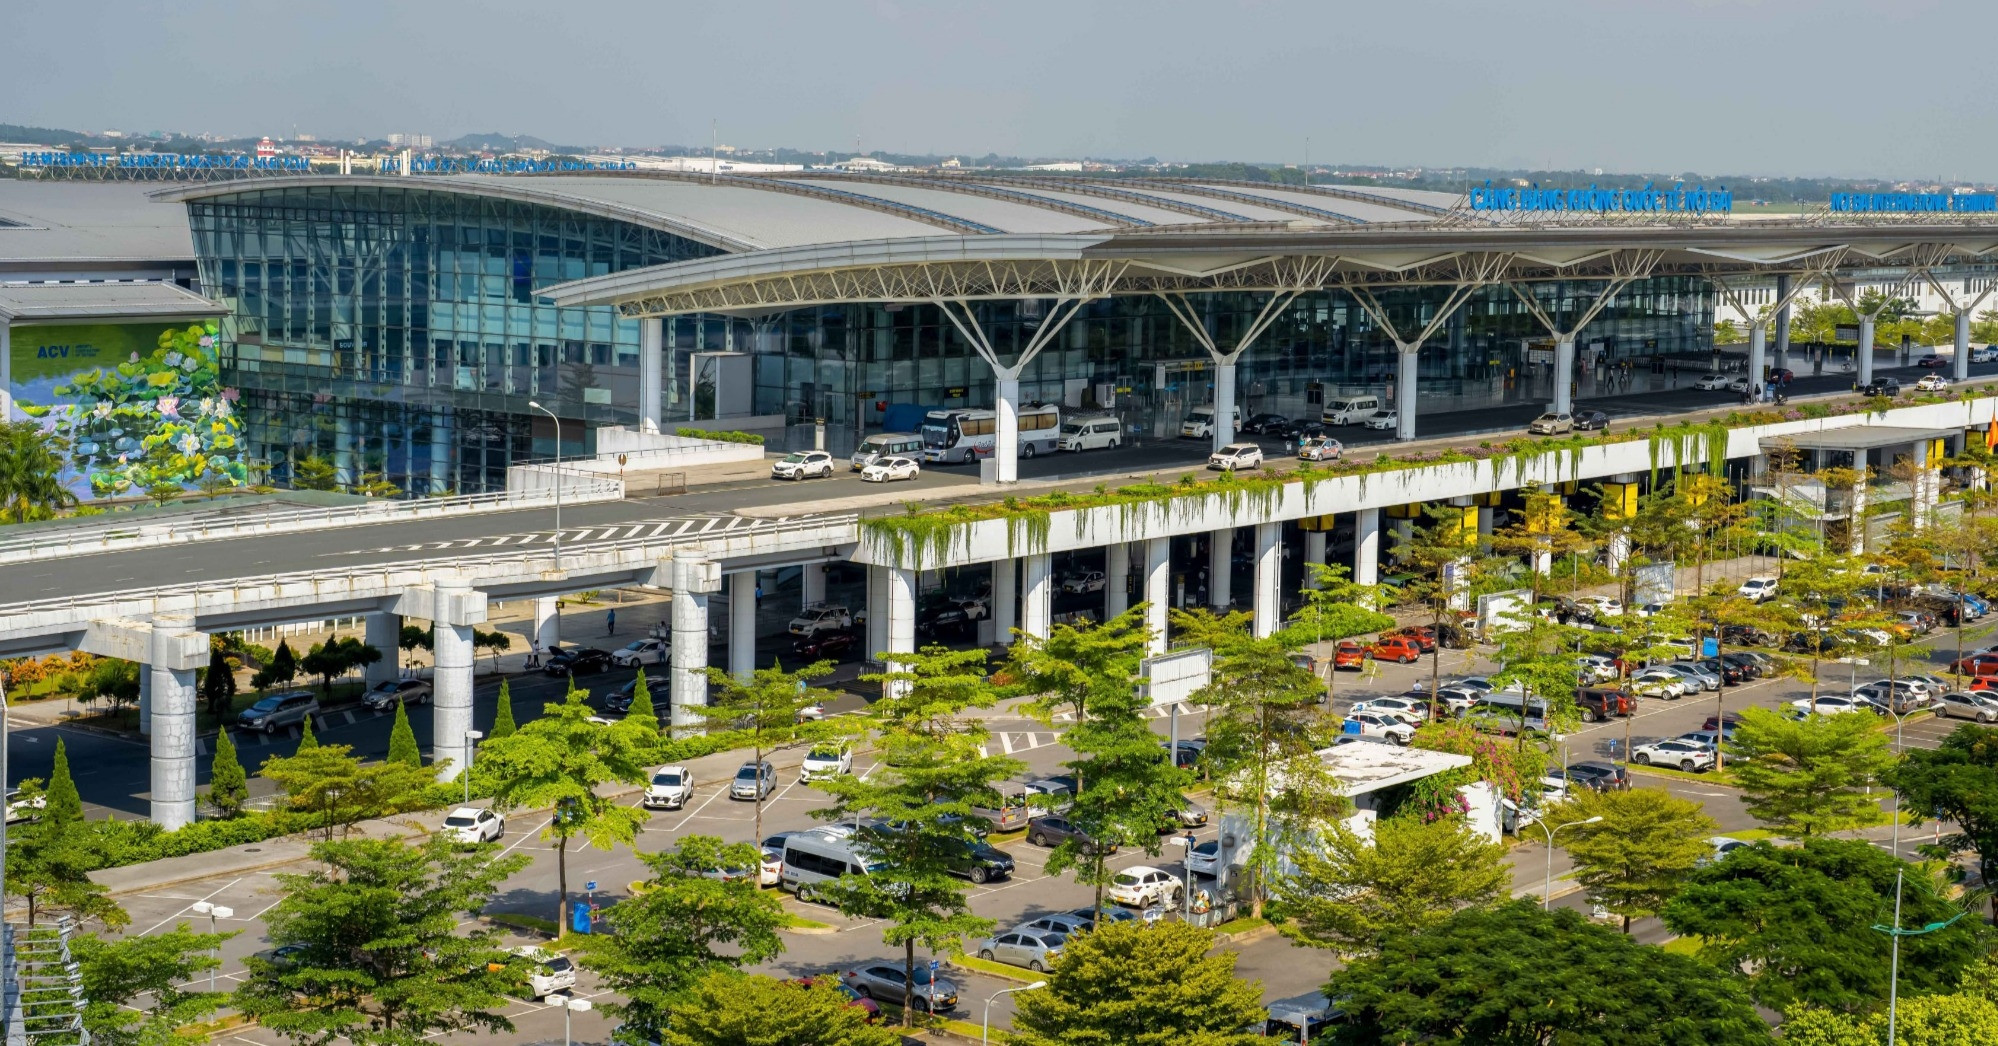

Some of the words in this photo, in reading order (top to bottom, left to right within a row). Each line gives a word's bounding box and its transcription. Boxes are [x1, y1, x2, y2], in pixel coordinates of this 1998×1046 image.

[1470, 178, 1517, 211] CẢNG
[1519, 182, 1564, 211] HÀNG
[1567, 183, 1619, 212] KHÔNG
[1622, 180, 1662, 212] QUỐC
[1710, 185, 1733, 212] BÀI
[37, 345, 70, 359] ACV
